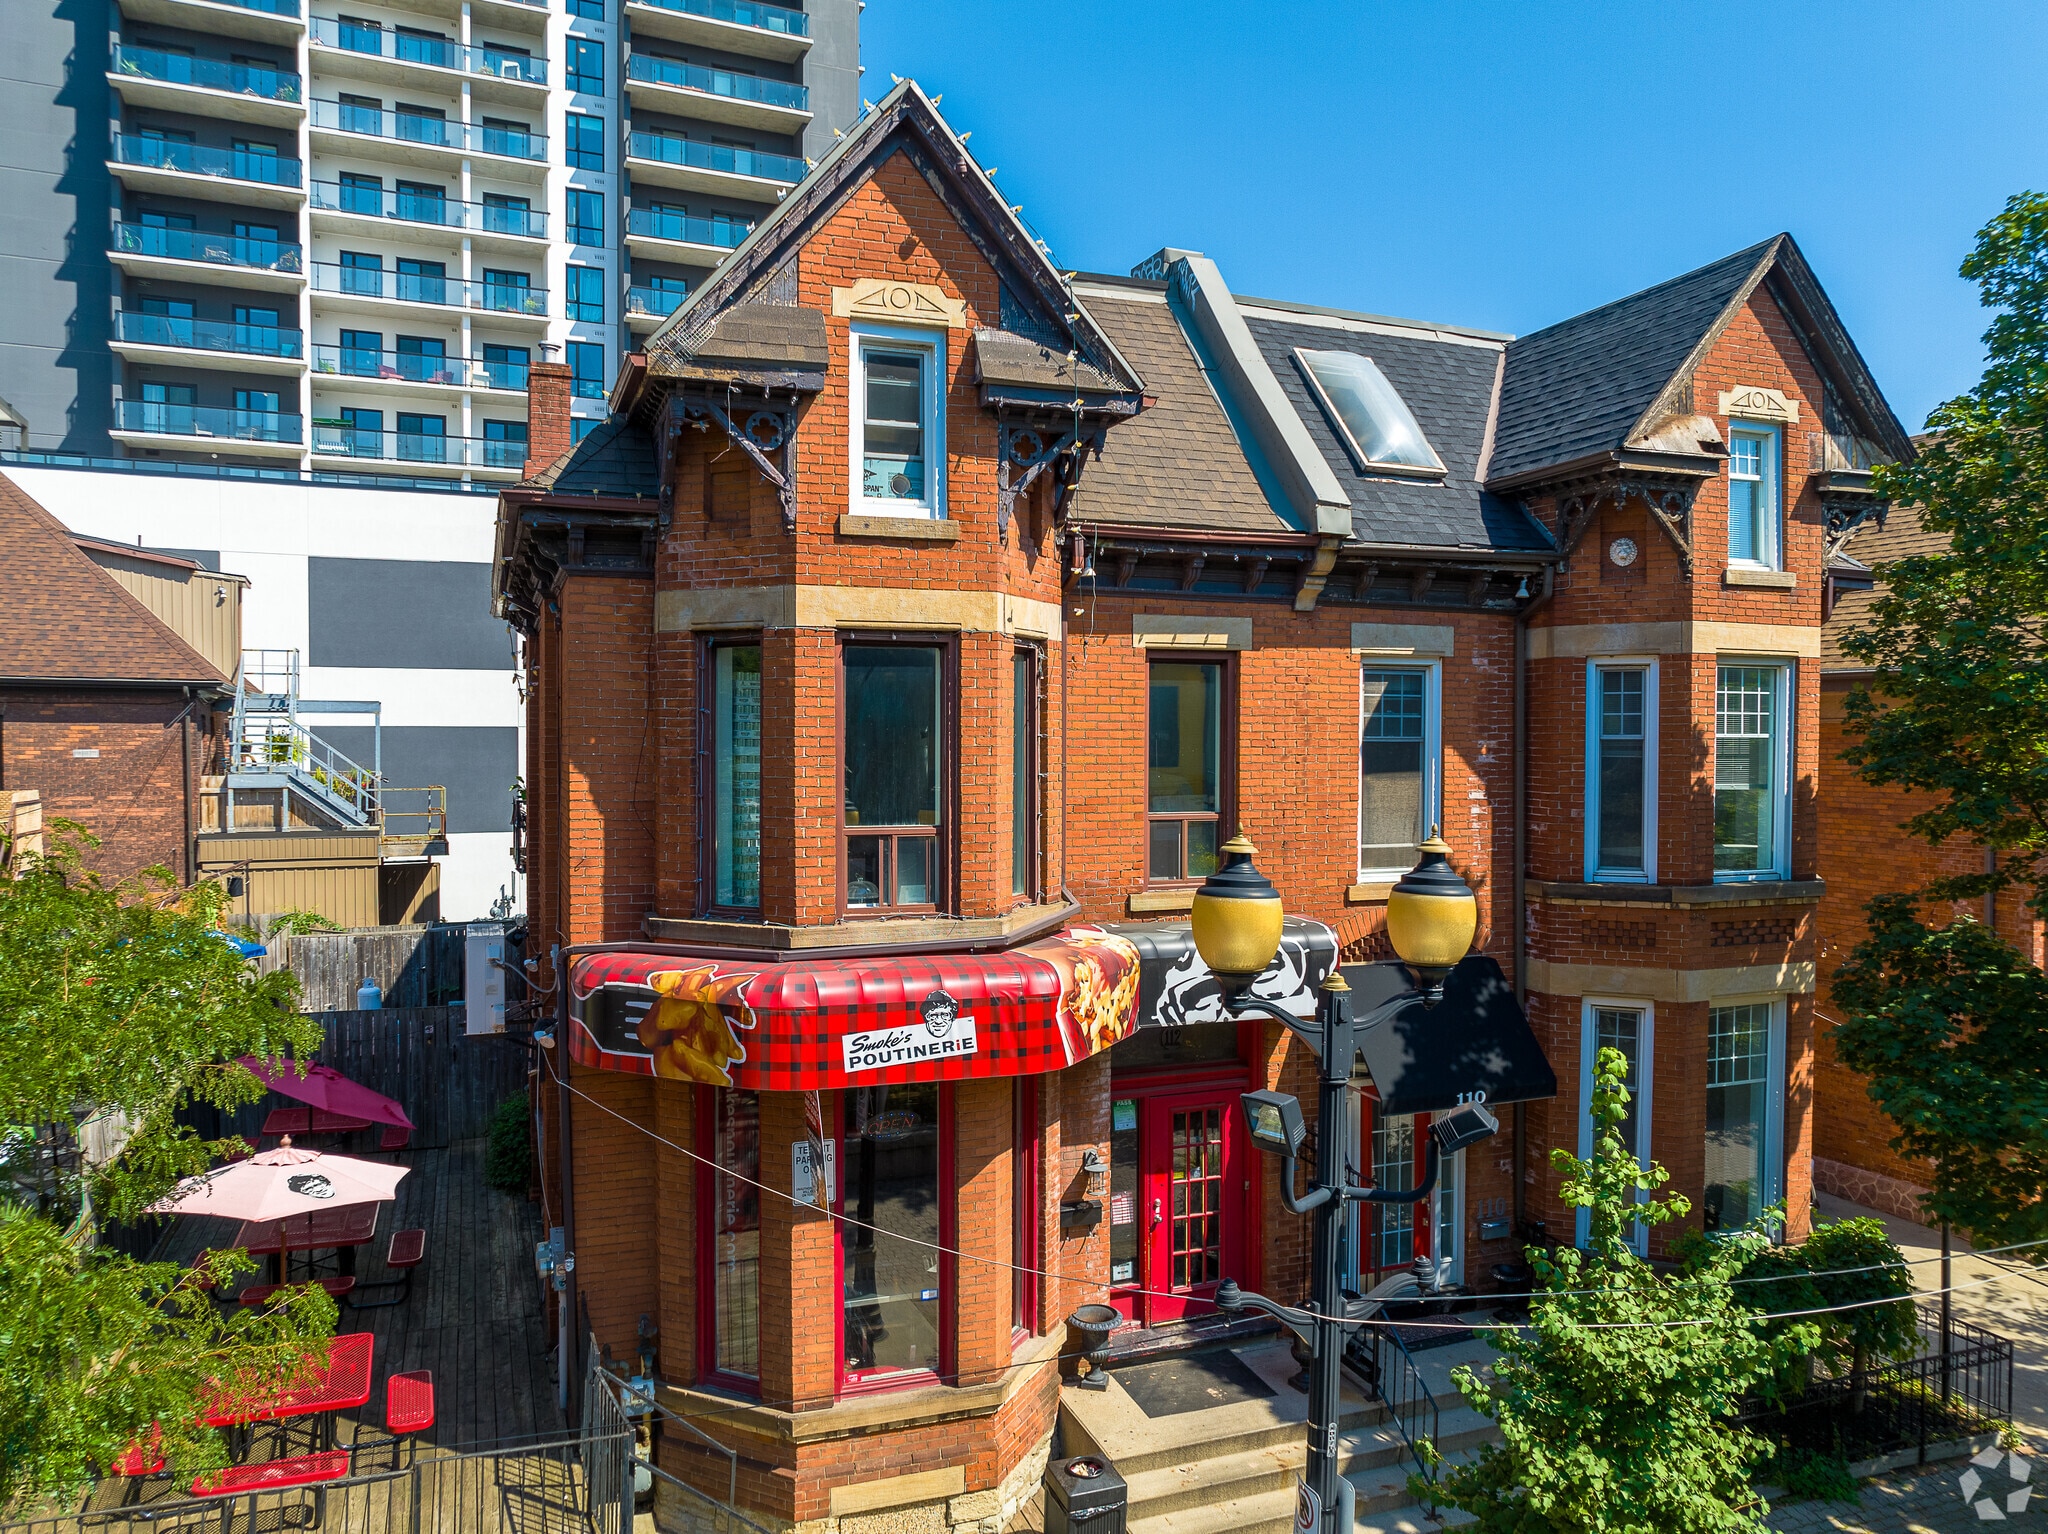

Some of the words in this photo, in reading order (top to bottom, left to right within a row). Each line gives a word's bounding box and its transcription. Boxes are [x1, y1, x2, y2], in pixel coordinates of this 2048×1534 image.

[849, 1031, 912, 1054] Smoke's
[1456, 1090, 1486, 1106] 110
[868, 1114, 914, 1135] OPEN
[1477, 1197, 1506, 1219] 110
